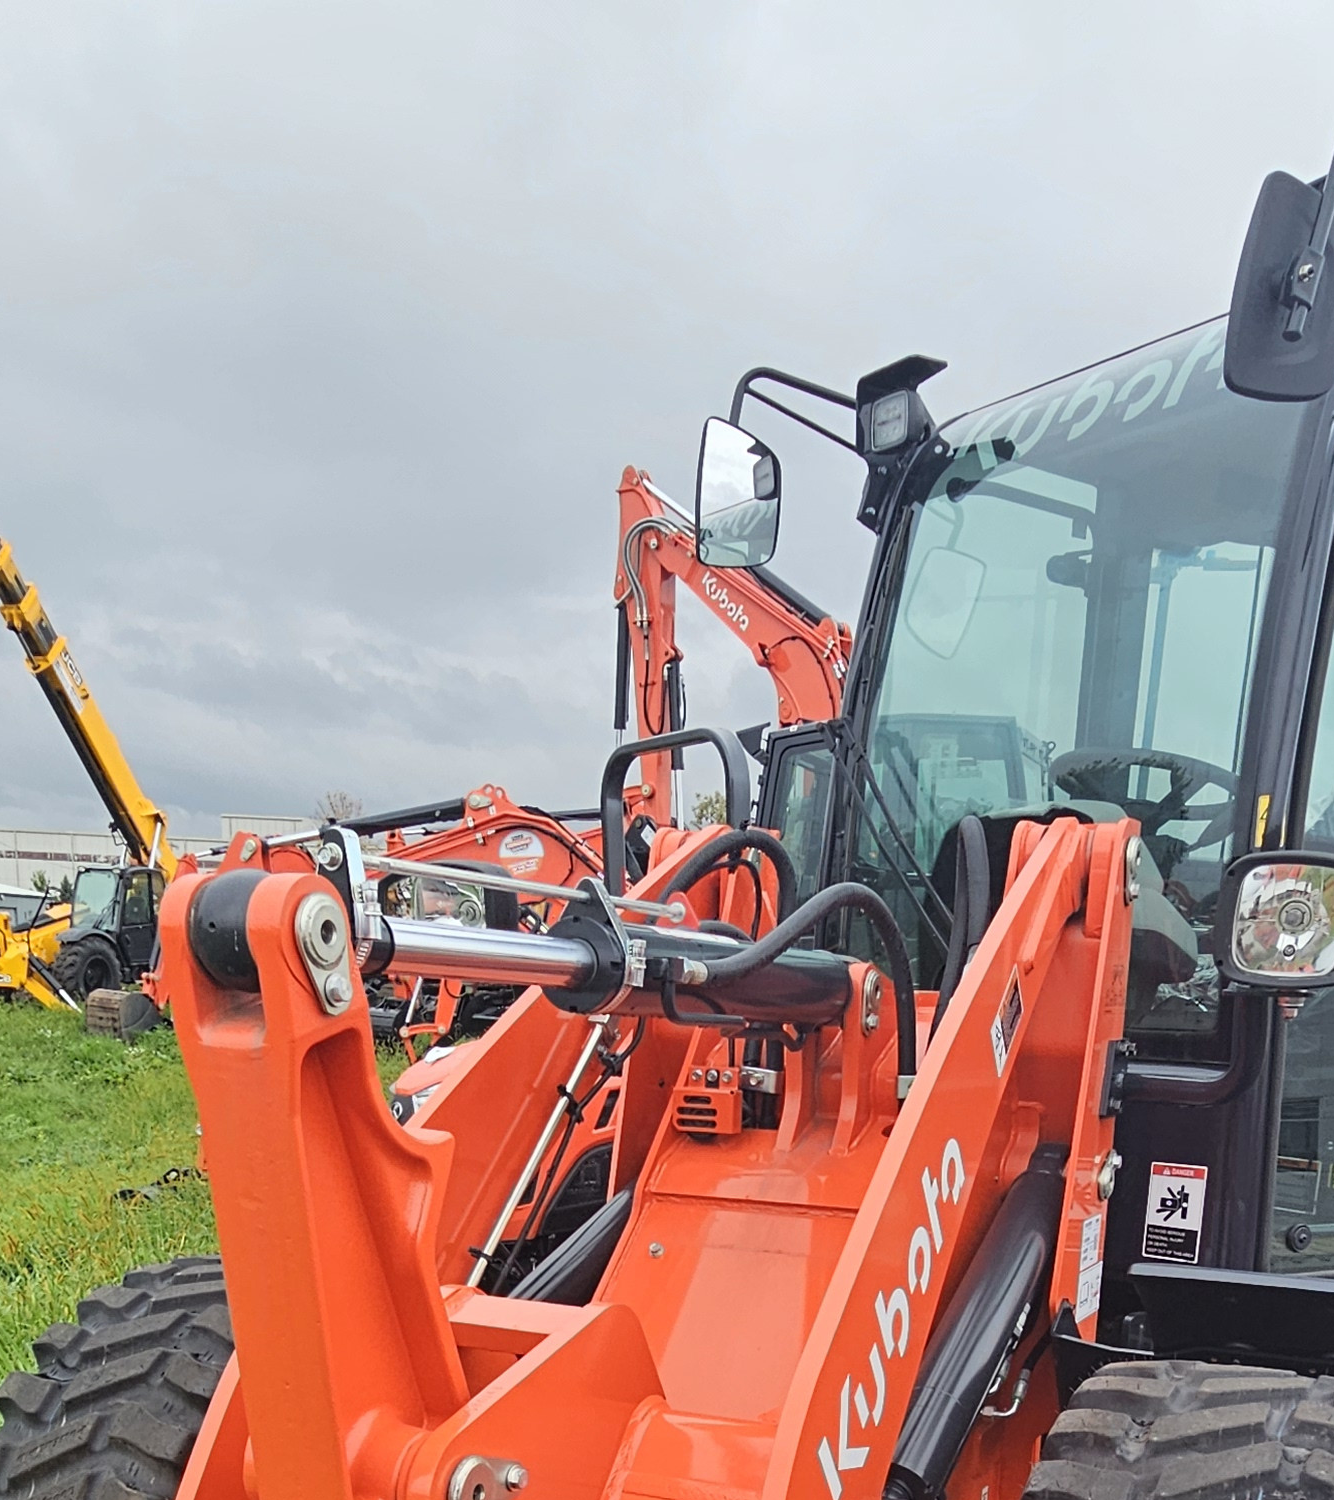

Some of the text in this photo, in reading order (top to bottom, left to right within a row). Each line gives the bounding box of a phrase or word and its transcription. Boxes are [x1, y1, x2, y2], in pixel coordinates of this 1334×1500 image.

[954, 322, 1225, 471] Kubot
[702, 570, 750, 632] Kubota
[60, 650, 83, 687] JCB
[1171, 1167, 1195, 1178] DANGER
